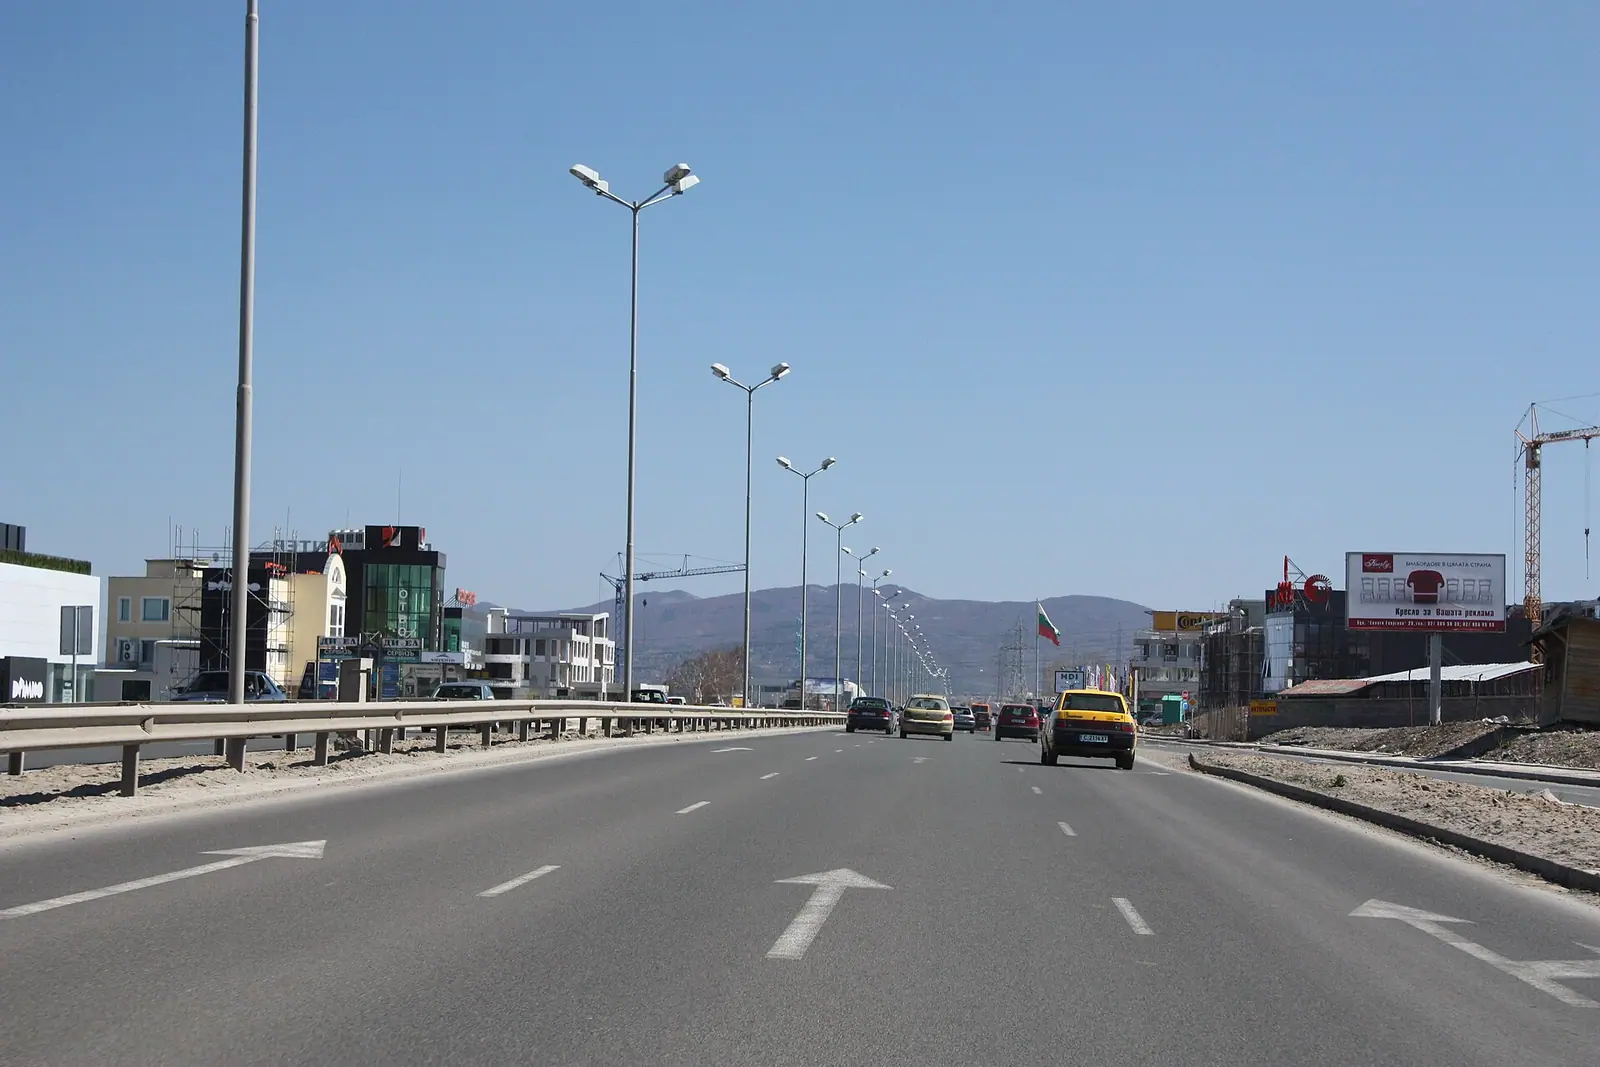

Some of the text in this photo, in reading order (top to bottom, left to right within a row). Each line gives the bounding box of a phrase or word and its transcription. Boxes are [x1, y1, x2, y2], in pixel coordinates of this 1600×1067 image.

[1395, 607, 1420, 617] Кресло
[1436, 608, 1463, 617] Вашата
[1464, 609, 1495, 618] реклама
